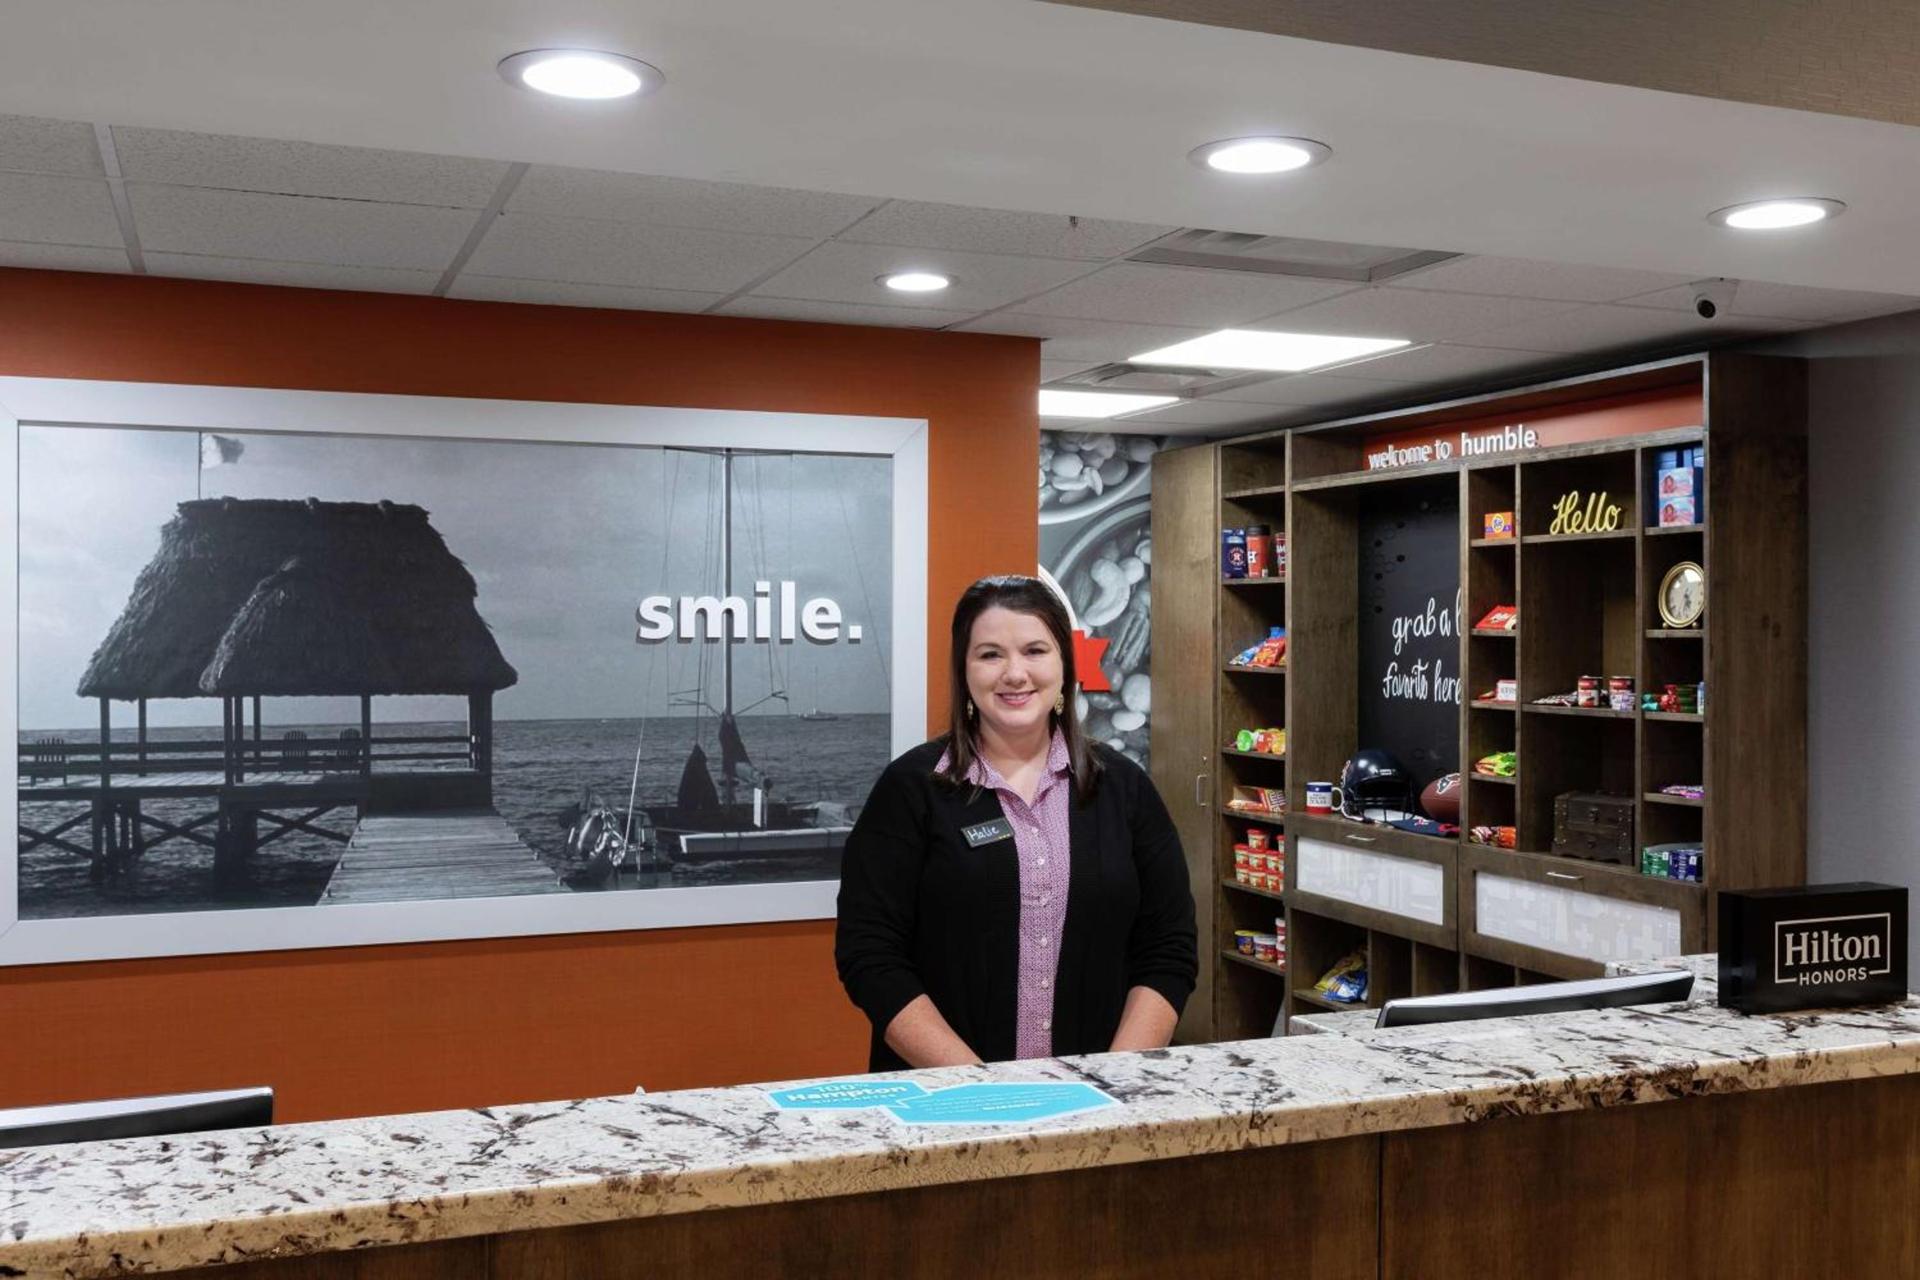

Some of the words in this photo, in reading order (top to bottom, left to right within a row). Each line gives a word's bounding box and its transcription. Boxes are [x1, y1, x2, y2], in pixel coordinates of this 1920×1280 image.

[1368, 444, 1433, 470] welcome
[1434, 439, 1453, 460] to
[1549, 490, 1622, 535] Hello
[637, 580, 863, 642] smile.
[1391, 596, 1436, 656] grab
[1440, 607, 1452, 637] a
[1434, 659, 1462, 705] here
[1784, 930, 1881, 966] Hilton
[1799, 967, 1868, 986] HONORS
[785, 1086, 907, 1101] Hampton
